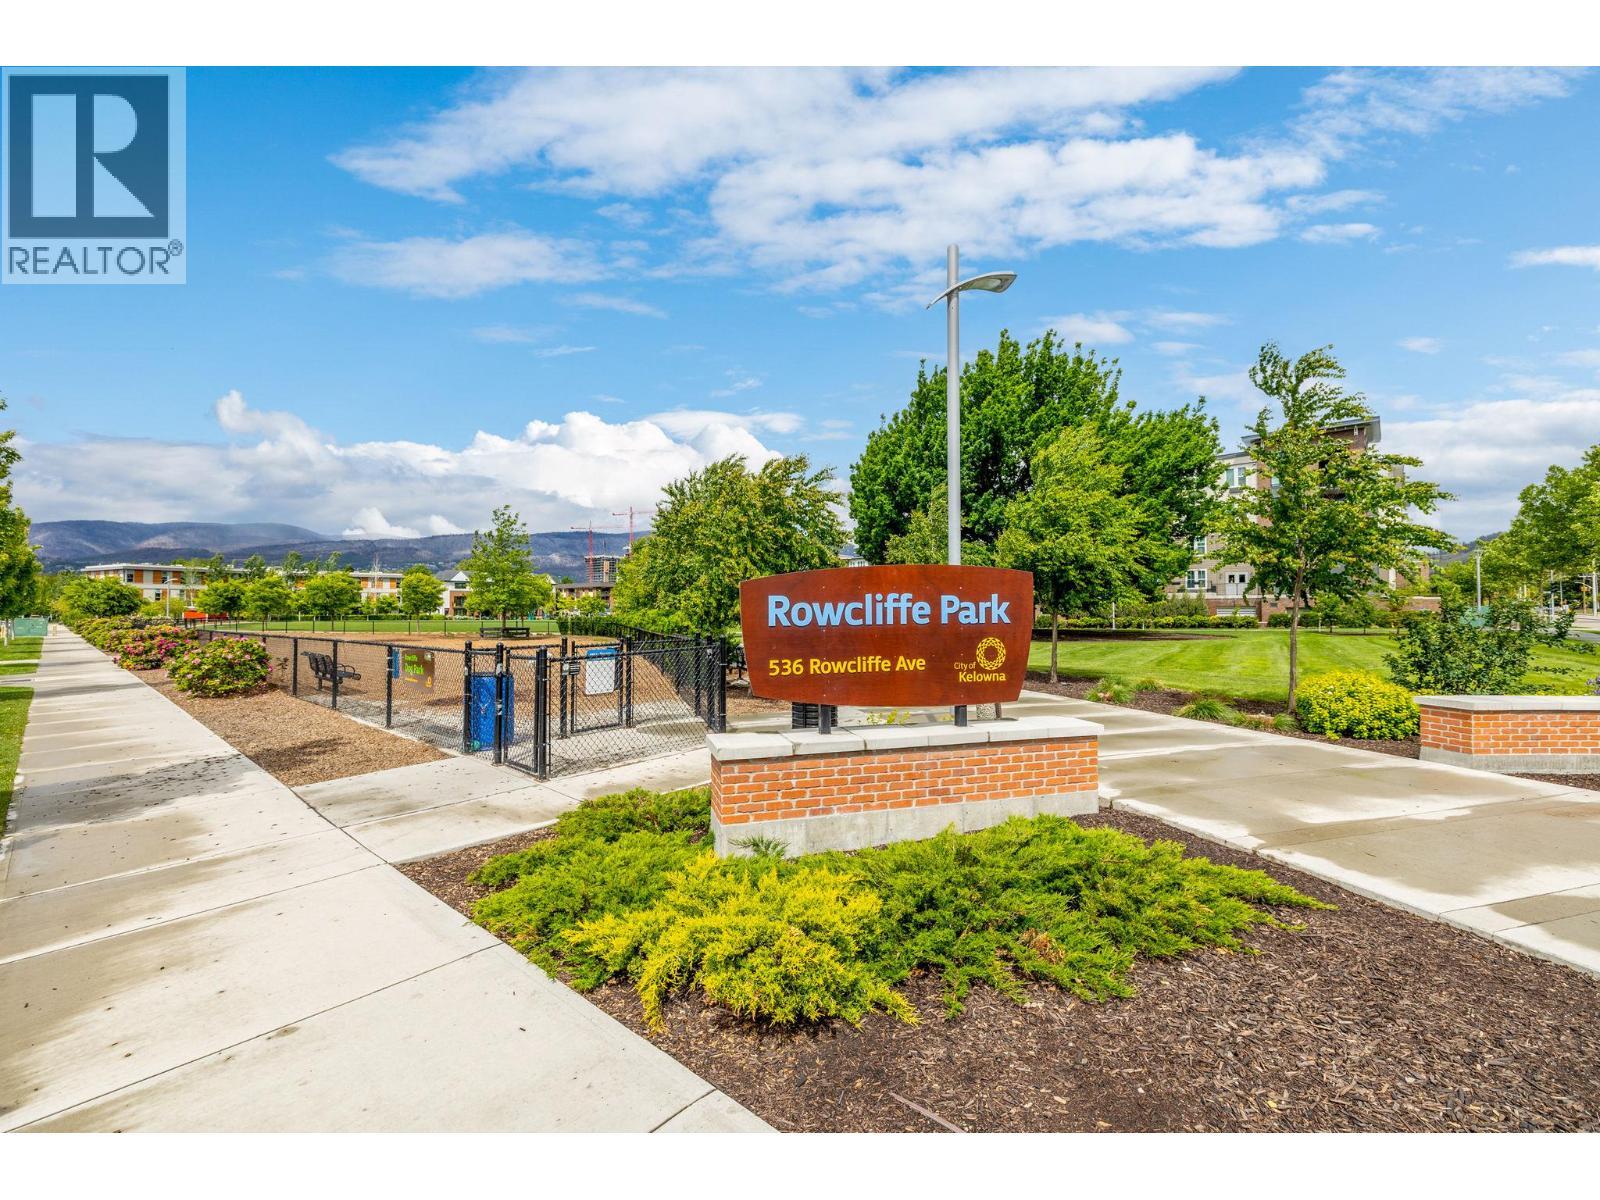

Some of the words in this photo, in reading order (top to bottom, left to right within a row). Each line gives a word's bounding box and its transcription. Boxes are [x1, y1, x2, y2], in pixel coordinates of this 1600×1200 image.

[767, 593, 931, 627] Rowcliffe
[940, 593, 1011, 624] Park
[768, 659, 804, 676] 536
[809, 656, 892, 675] Rowcliffe
[895, 656, 926, 671] Ave
[953, 662, 968, 671] City
[968, 661, 977, 670] of
[959, 671, 1007, 683] Kelowna
